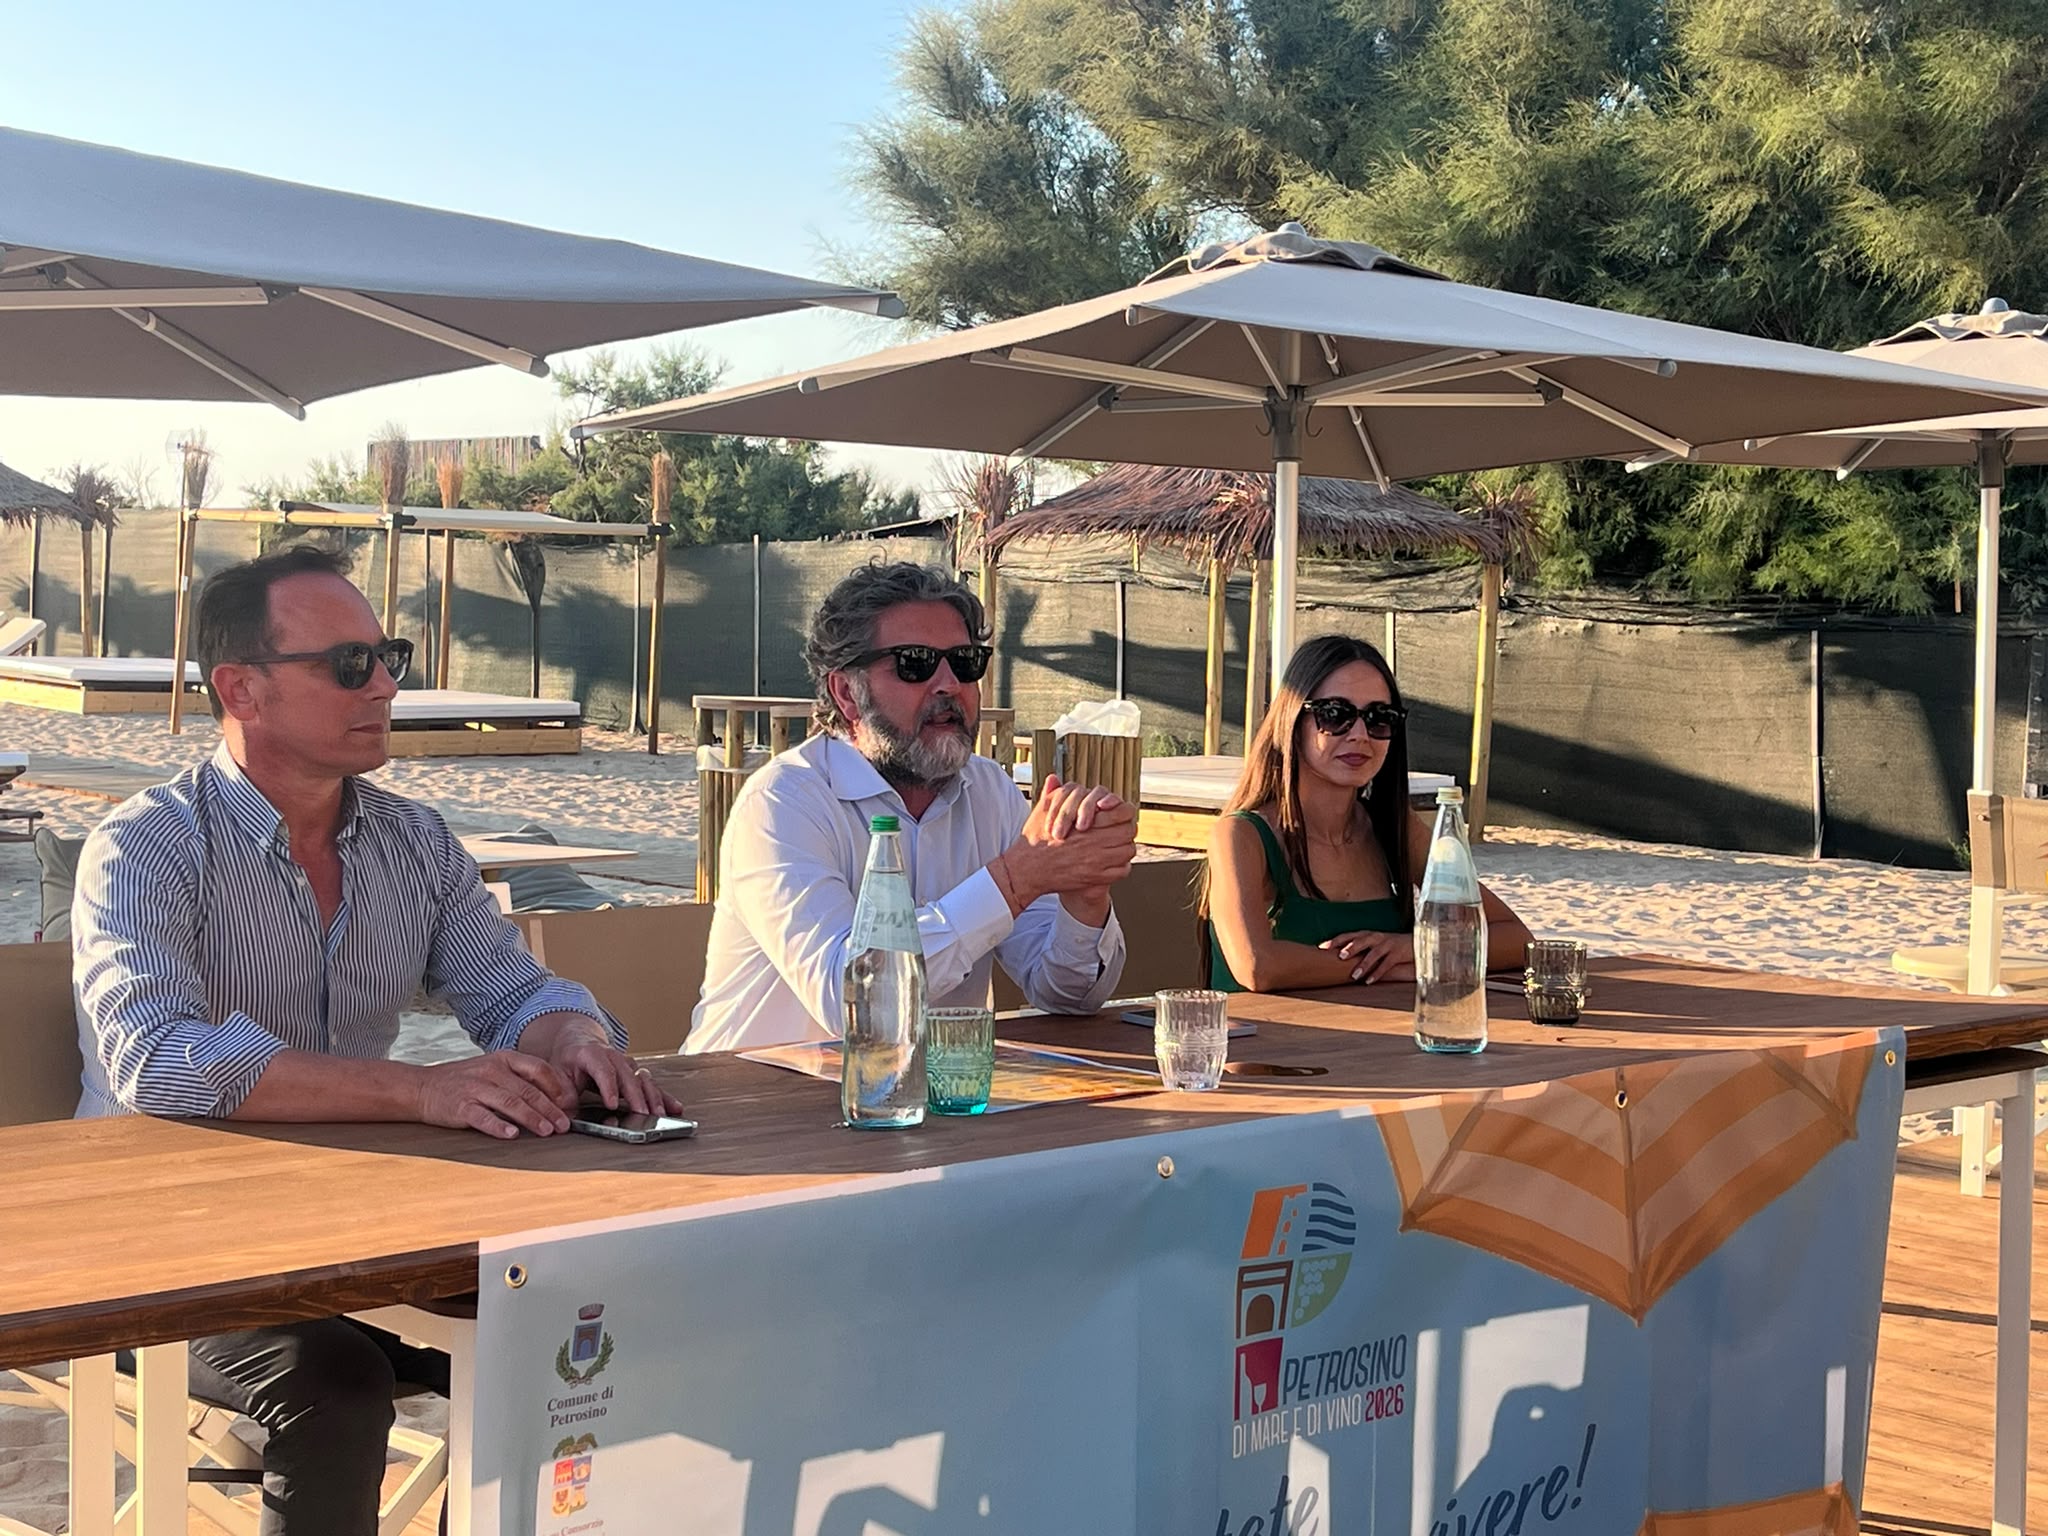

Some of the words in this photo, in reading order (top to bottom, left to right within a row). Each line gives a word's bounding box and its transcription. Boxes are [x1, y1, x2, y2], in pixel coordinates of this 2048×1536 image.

[547, 1391, 598, 1412] Comune
[601, 1385, 614, 1400] di
[1283, 1334, 1407, 1405] PETROSINO
[550, 1405, 607, 1428] Petrosino
[1233, 1424, 1246, 1459] DI
[1251, 1411, 1288, 1453] MARE
[1293, 1407, 1302, 1438] E
[1307, 1402, 1321, 1436] DI
[1327, 1394, 1361, 1431] VINO
[1365, 1384, 1404, 1422] 2026
[1429, 1424, 1596, 1536] ivere!
